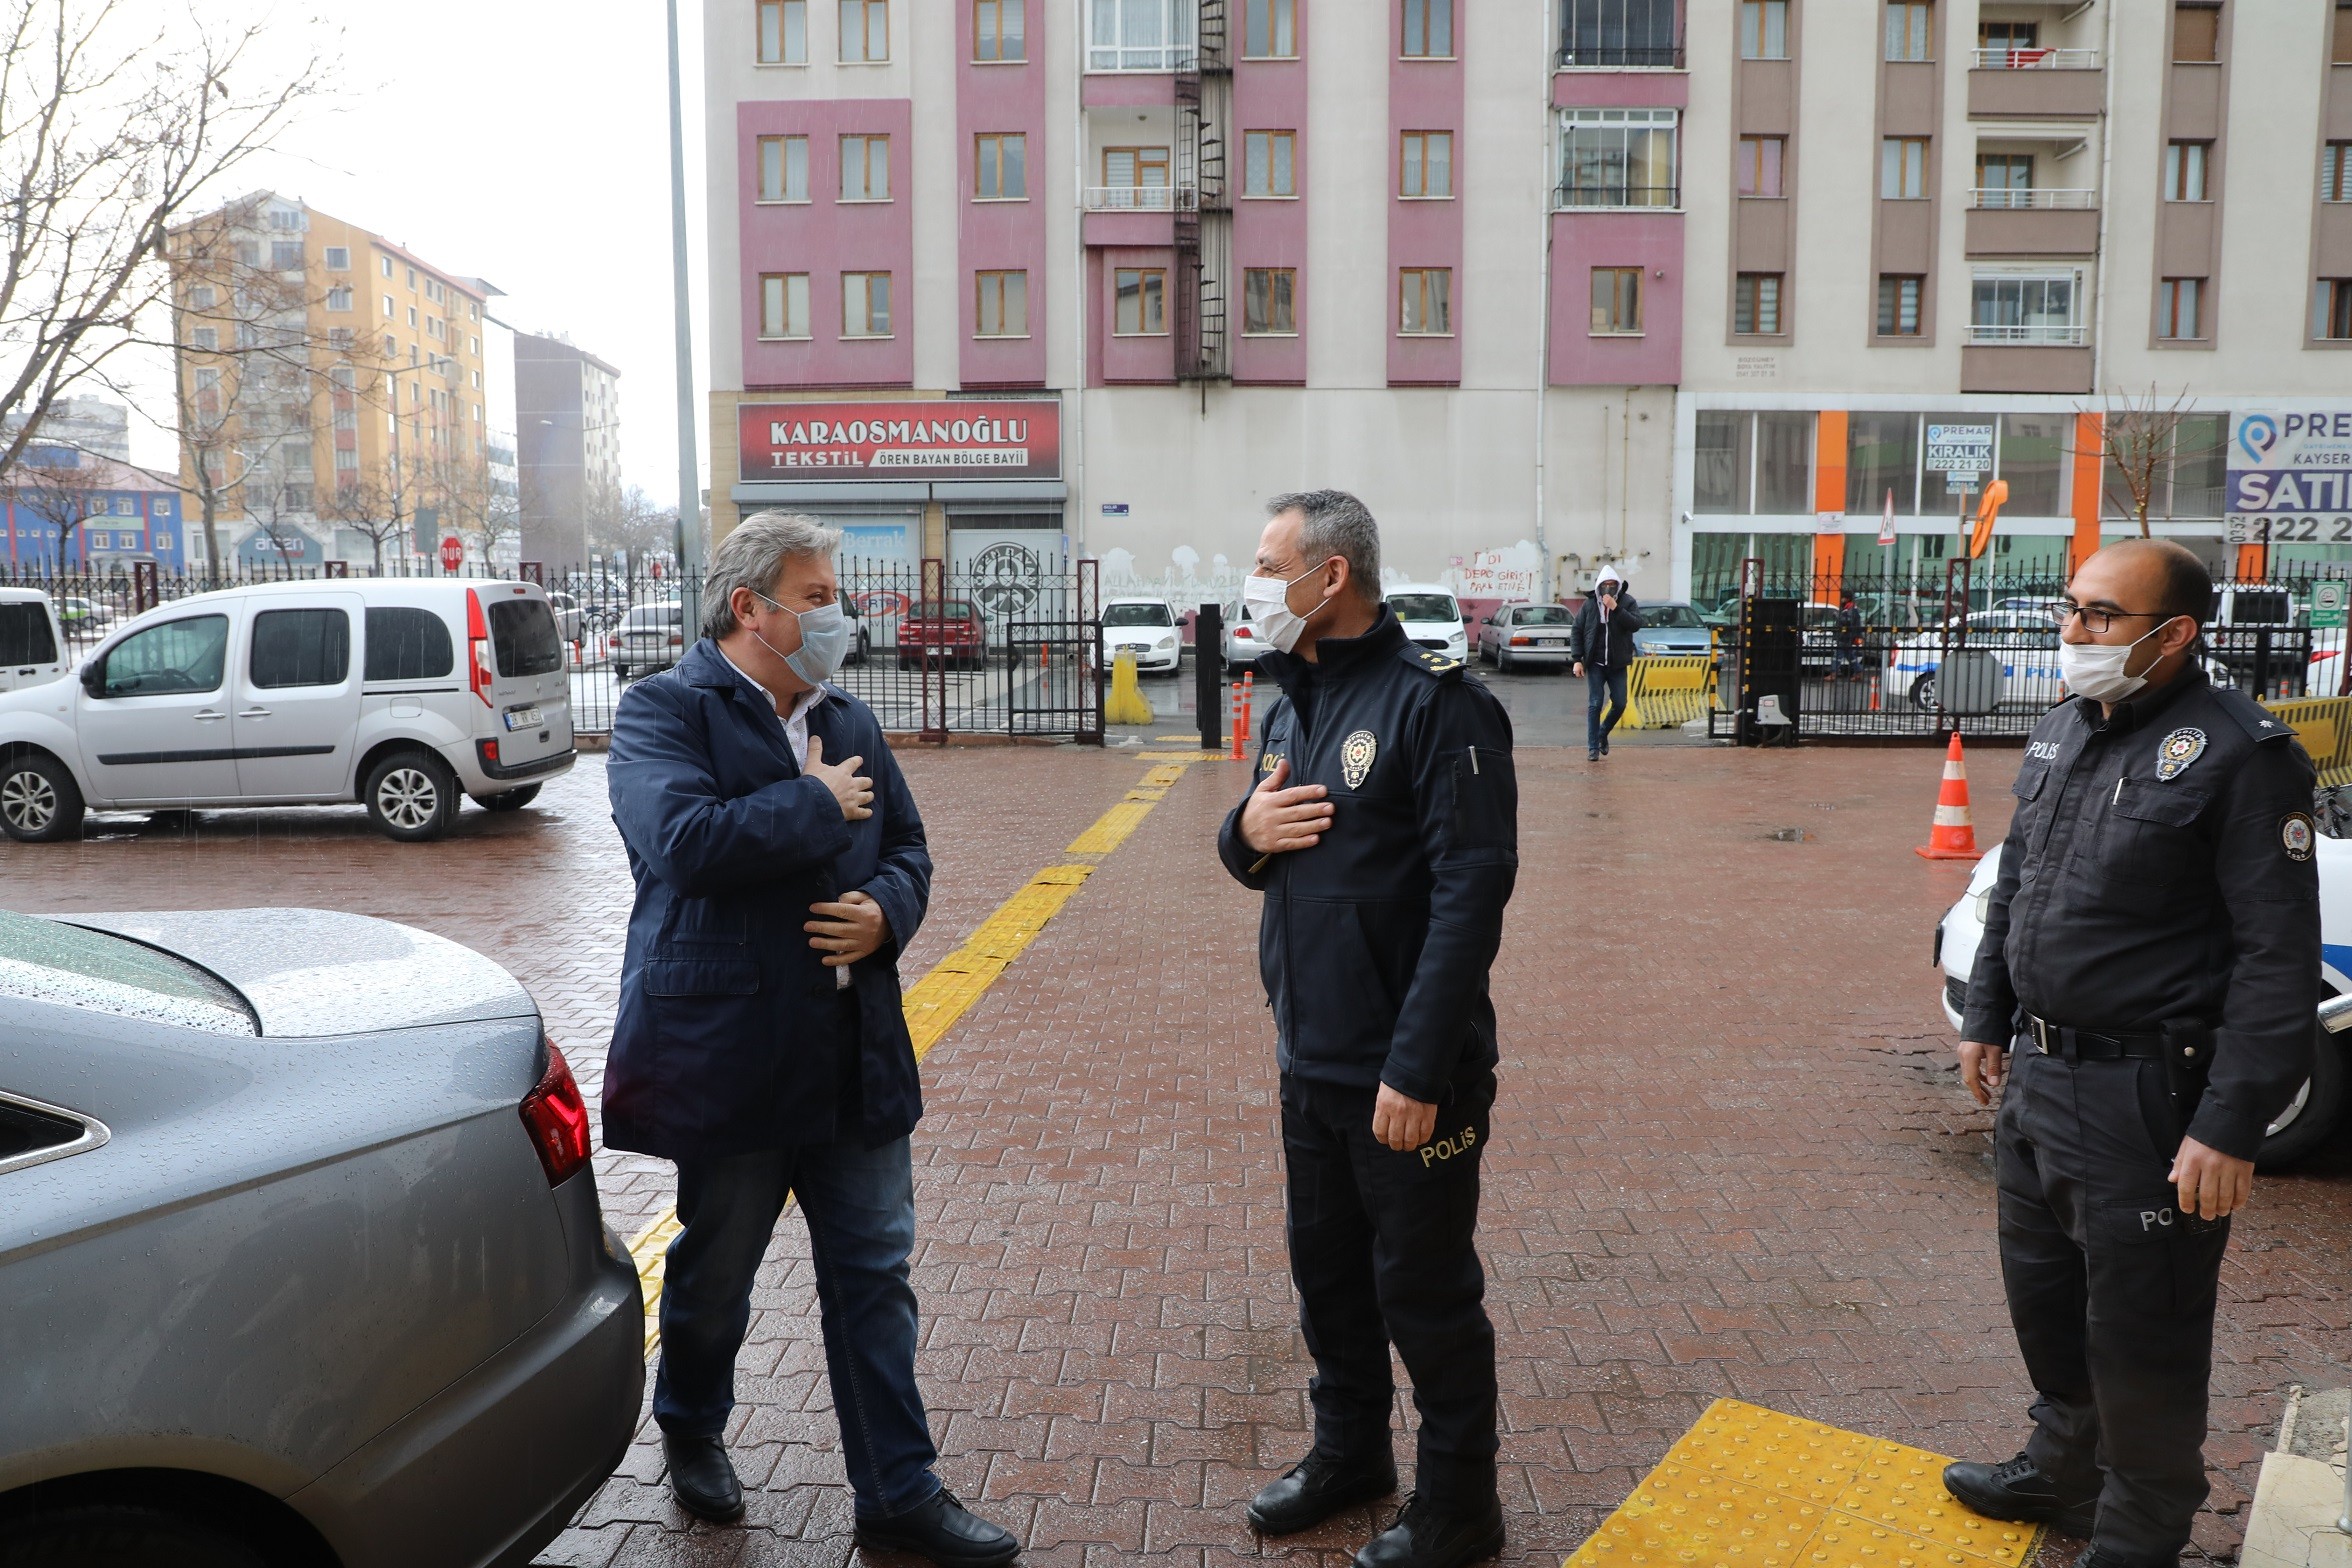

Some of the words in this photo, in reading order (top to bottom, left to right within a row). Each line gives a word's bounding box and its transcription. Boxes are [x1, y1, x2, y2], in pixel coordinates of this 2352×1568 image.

[770, 415, 1028, 445] KARAOSMANOĞLU
[1943, 427, 1991, 435] PREMAR
[2284, 413, 2352, 438] PRE
[879, 451, 910, 465] ÖREN
[913, 454, 951, 464] BAYAN
[953, 450, 990, 464] BÖLGE
[2293, 453, 2350, 464] KAYSER
[1935, 460, 1955, 469] 222
[1959, 460, 1972, 469] 21
[1976, 460, 1990, 469] 20
